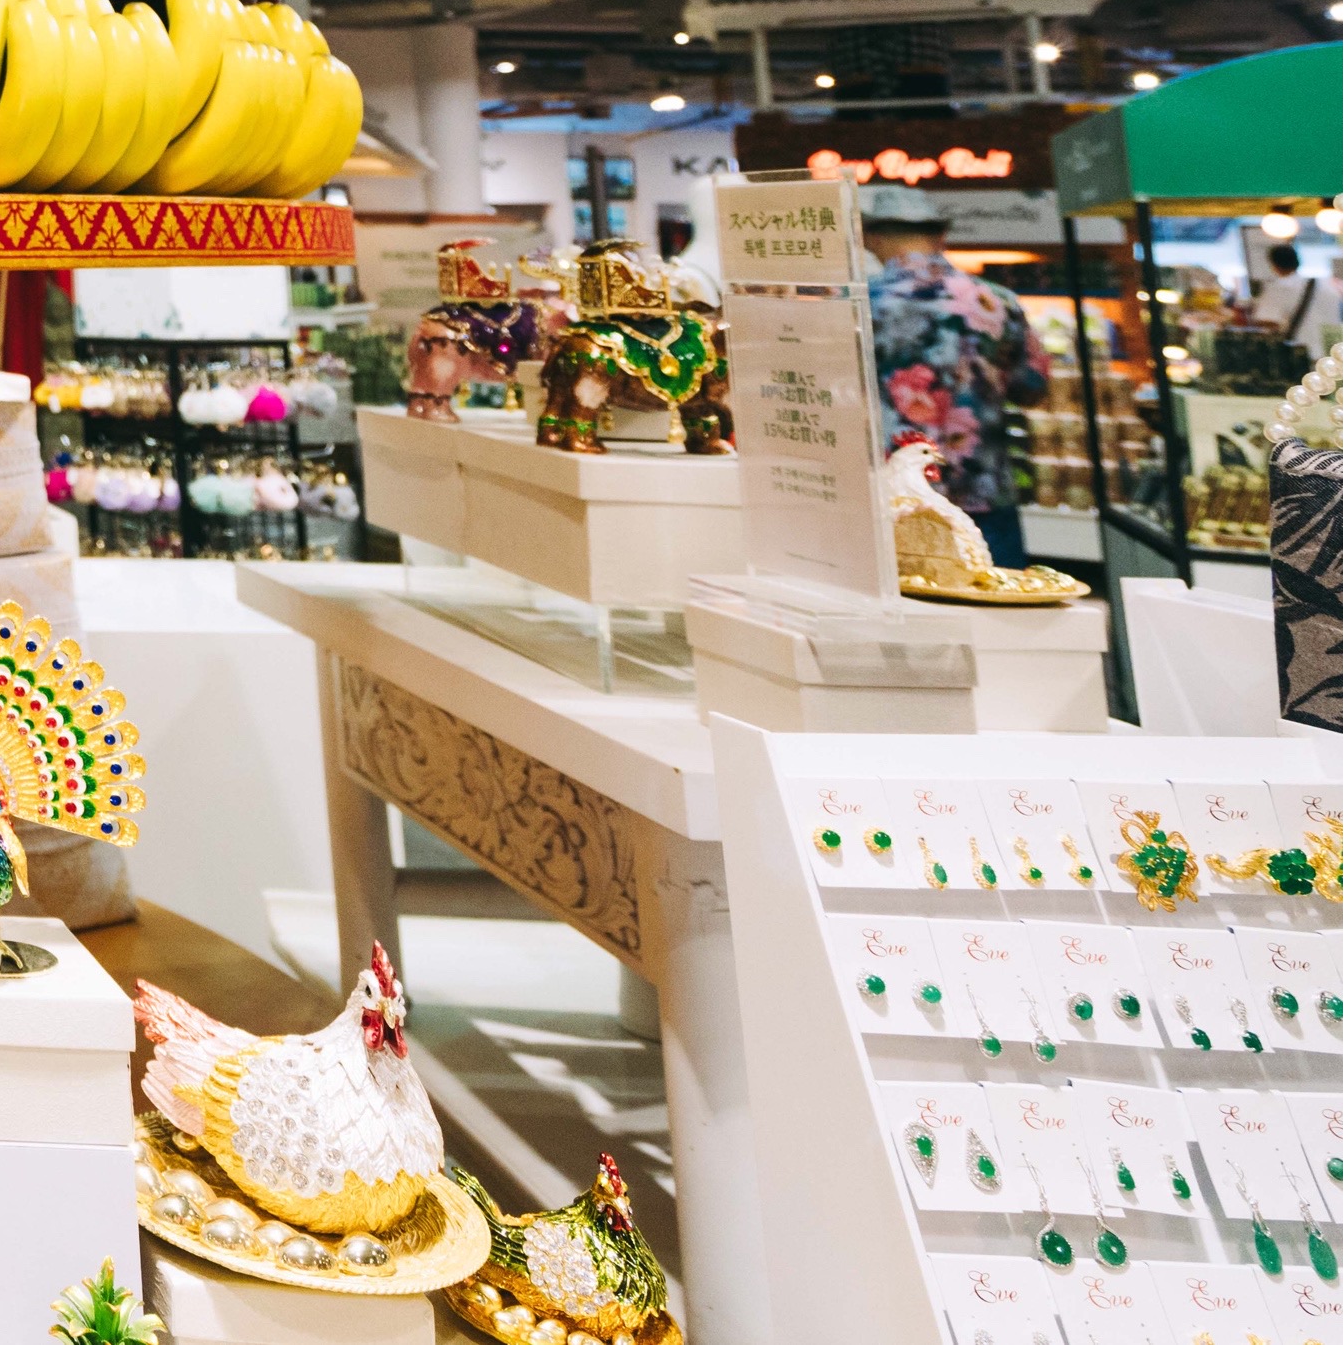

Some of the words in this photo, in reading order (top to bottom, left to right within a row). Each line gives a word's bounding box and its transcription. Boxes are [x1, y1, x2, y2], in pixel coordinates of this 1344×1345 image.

[818, 788, 861, 816] Eve
[913, 789, 958, 817] Eve
[1007, 789, 1054, 817] Eve
[1205, 794, 1250, 821] Eve
[862, 928, 908, 957] Eve
[962, 933, 1009, 962] Eve
[1060, 936, 1108, 965] Eve
[1167, 941, 1215, 971] Eve
[1267, 942, 1311, 972] Eve
[915, 1097, 962, 1129] Eve
[1018, 1099, 1065, 1130] Eve
[1107, 1096, 1155, 1129] Eve
[1219, 1103, 1267, 1135] Eve
[967, 1269, 1019, 1305] Eve
[1082, 1275, 1134, 1311] Eve
[1186, 1277, 1238, 1312] Eve
